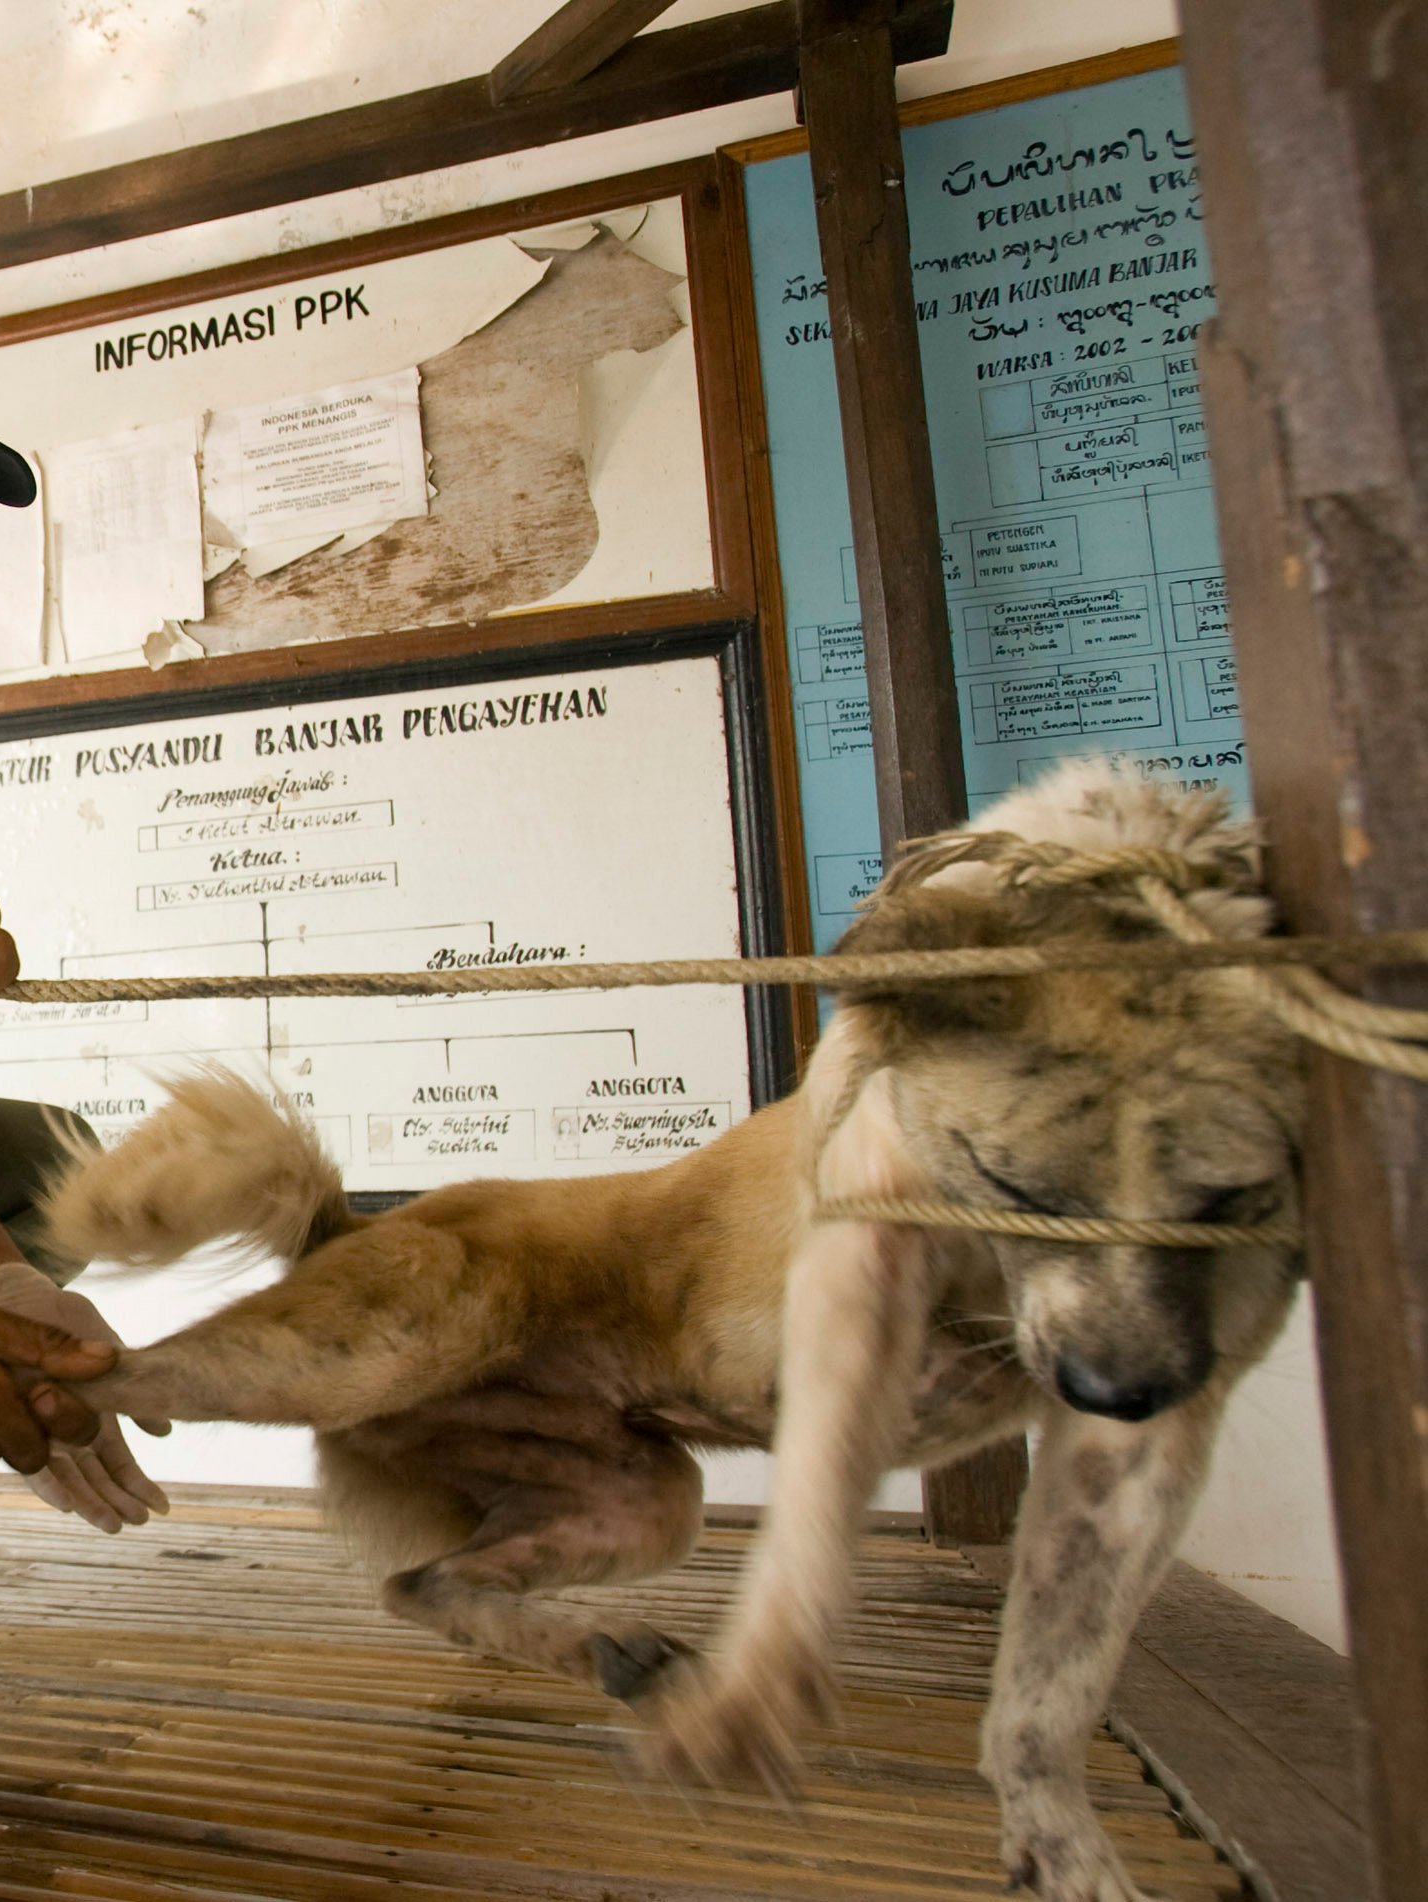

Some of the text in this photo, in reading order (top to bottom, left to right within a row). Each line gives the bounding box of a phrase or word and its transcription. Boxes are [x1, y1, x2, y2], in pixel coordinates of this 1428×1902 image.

[976, 164, 1201, 231] PEPALIHAN PRA
[947, 282, 1001, 317] JAYA
[1009, 267, 1101, 308] KUSUMA
[1108, 246, 1198, 284] BANJAR
[95, 283, 370, 373] INFORMASI PPK
[1074, 335, 1128, 363] 2002
[1162, 322, 1202, 347] 200
[261, 394, 374, 428] INDONESIA BERDUKA
[277, 408, 358, 436] PPK MENANGIS
[1006, 540, 1057, 554] SUASTIKA
[75, 733, 223, 779] POSYANDU
[255, 713, 384, 757] BANJAR
[403, 686, 608, 740] PENGAYEHAN
[157, 784, 269, 813] Penanggung
[412, 1085, 499, 1104] ANGGOTA
[585, 1076, 687, 1098] ANGGOTA
